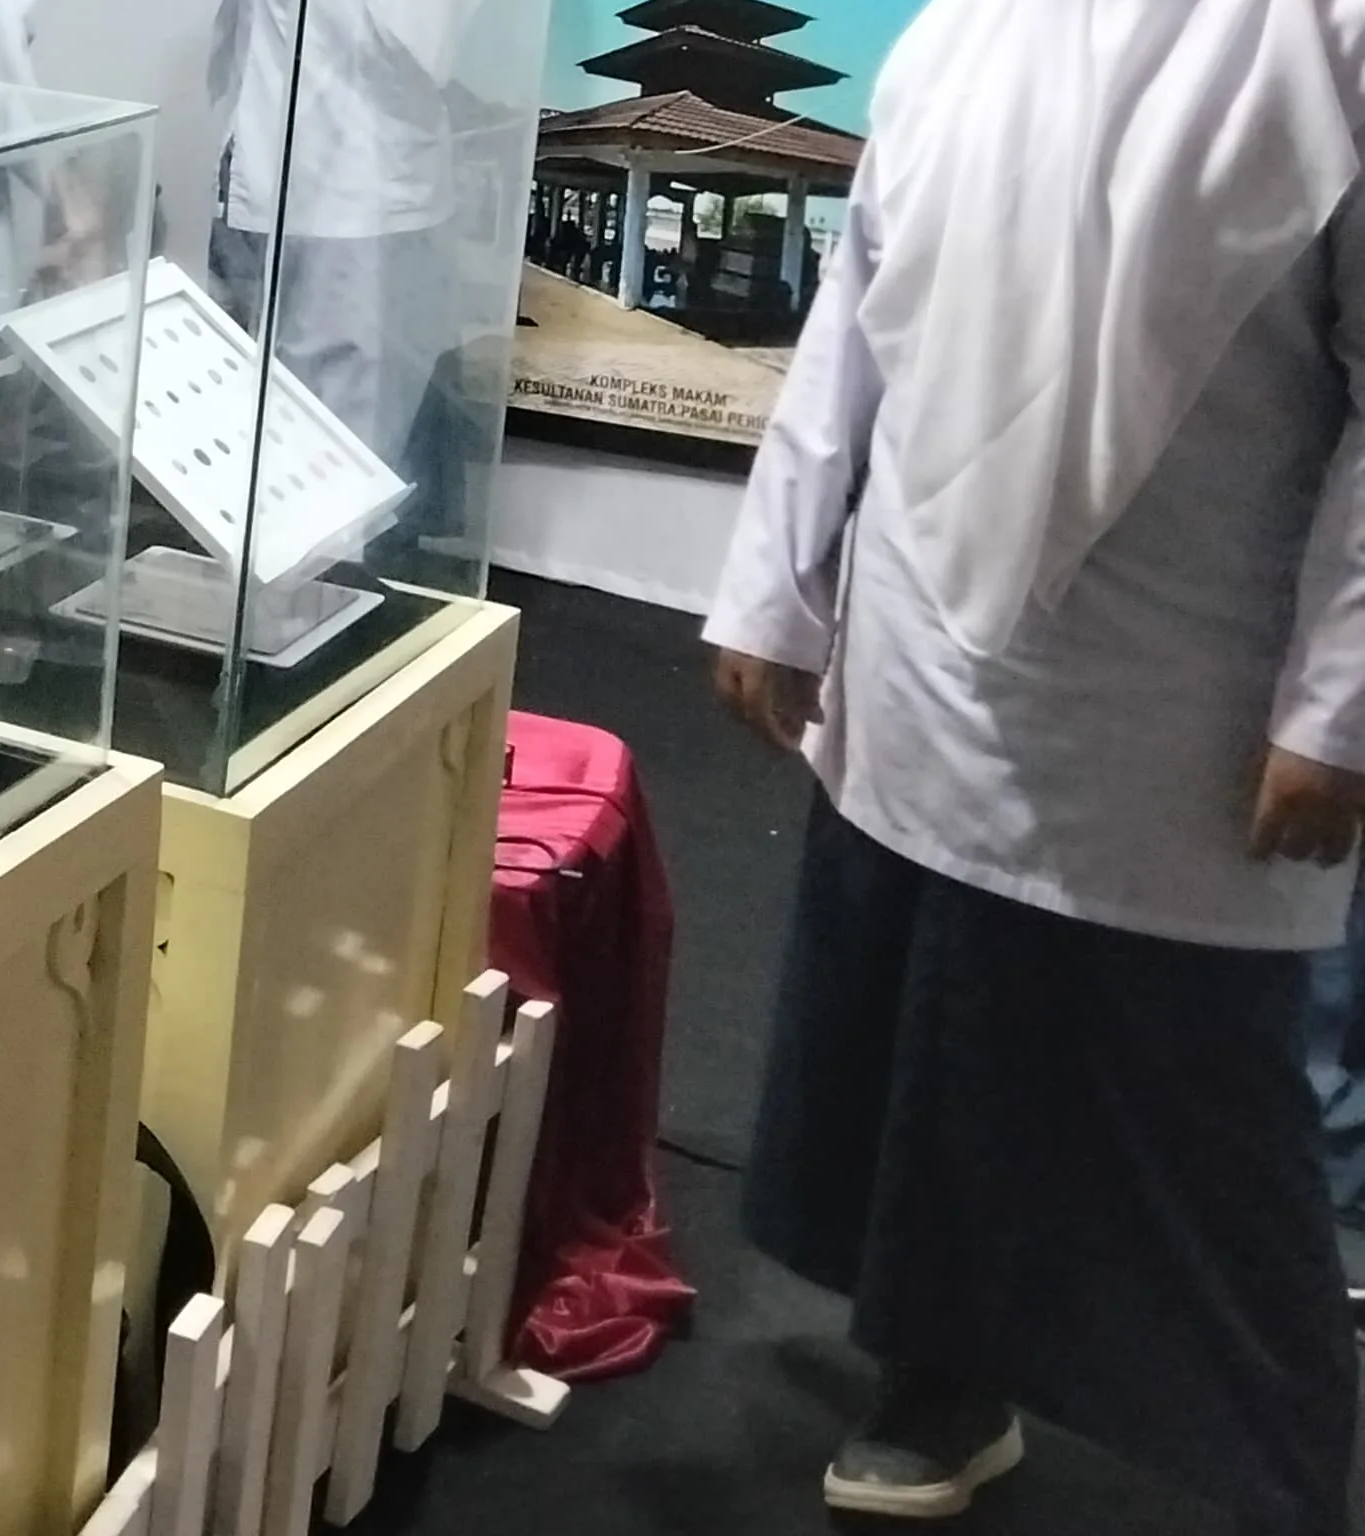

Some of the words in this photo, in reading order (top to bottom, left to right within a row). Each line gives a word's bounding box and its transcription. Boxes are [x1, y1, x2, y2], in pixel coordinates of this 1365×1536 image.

[514, 378, 603, 405] KESULTANAN
[608, 393, 676, 417] SUMATRA
[681, 404, 723, 424] PASAI
[589, 374, 667, 400] KOMPLEKS
[672, 386, 728, 407] MAKAM
